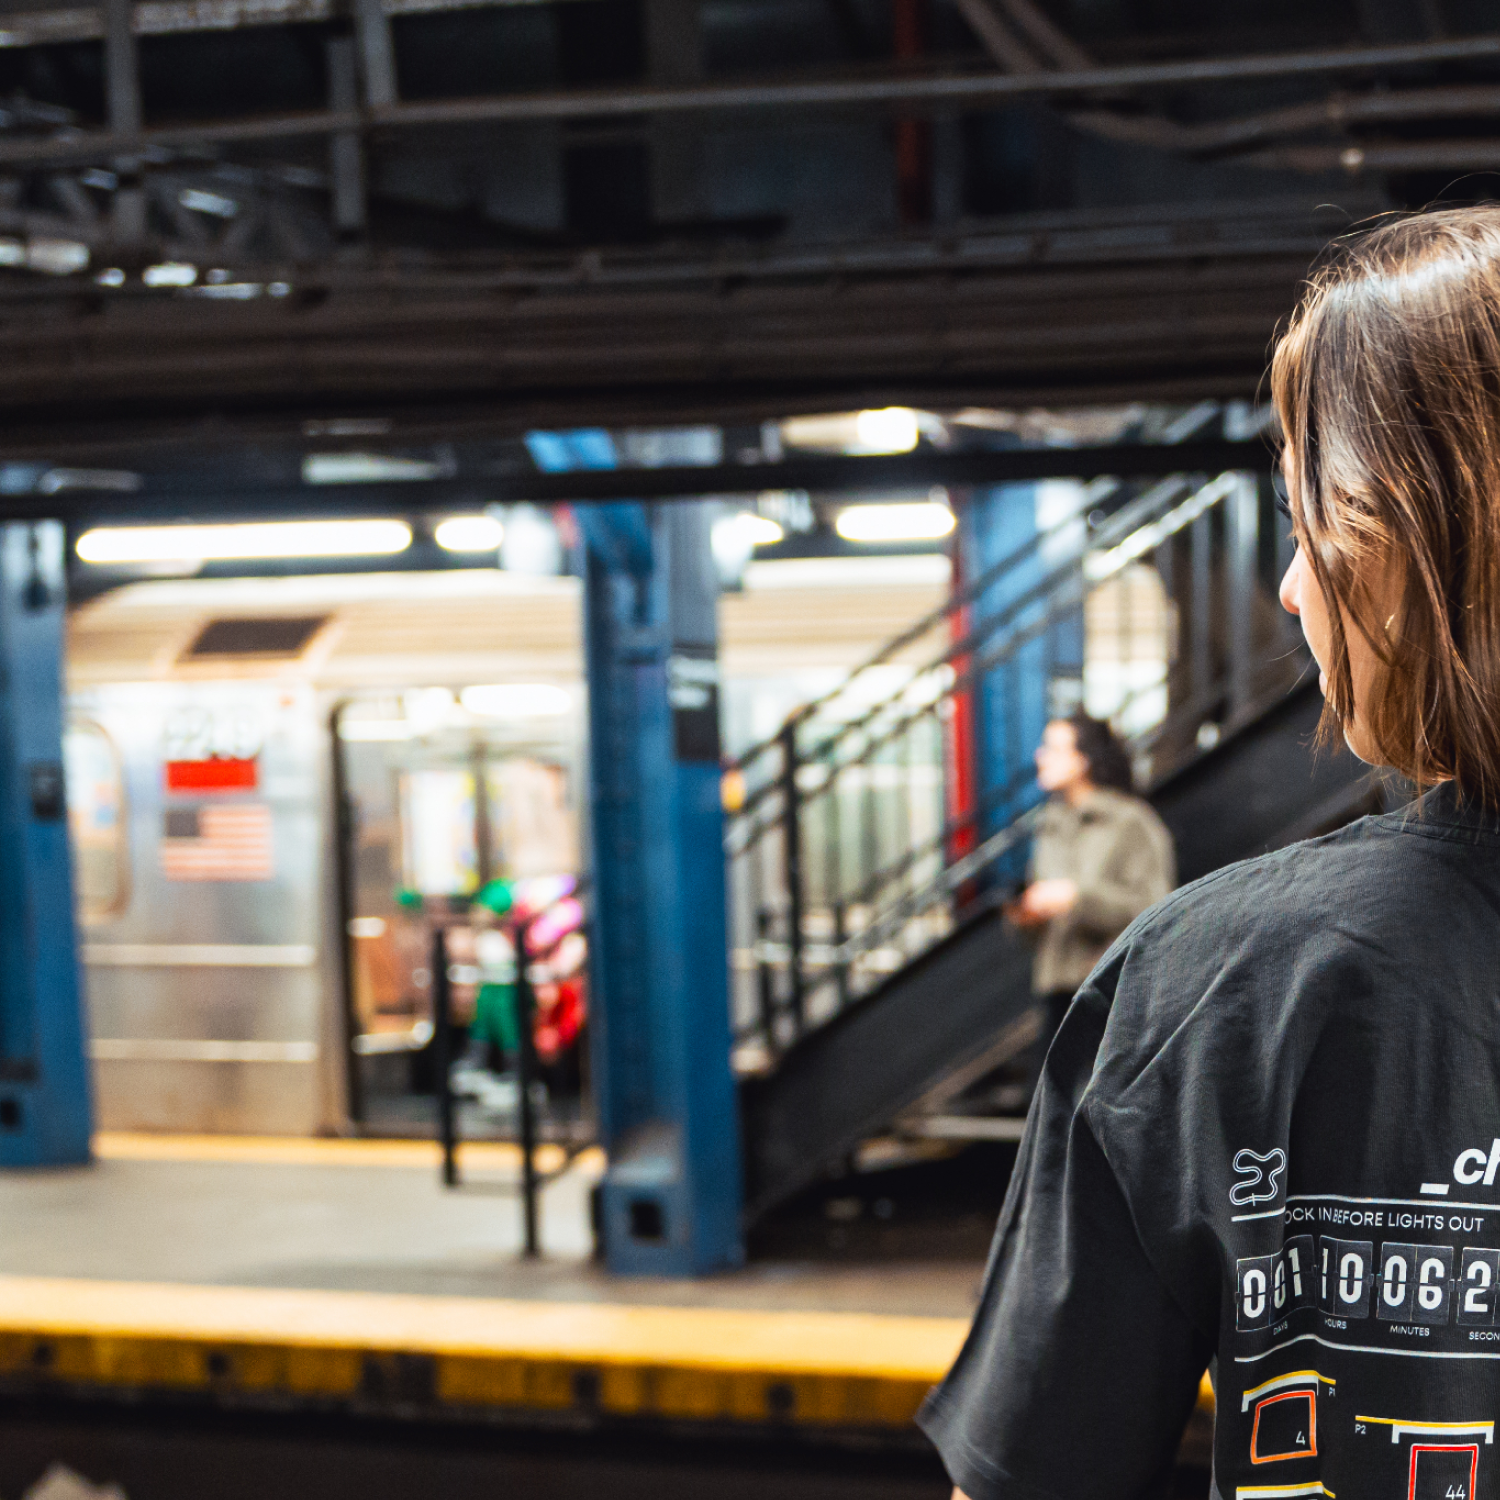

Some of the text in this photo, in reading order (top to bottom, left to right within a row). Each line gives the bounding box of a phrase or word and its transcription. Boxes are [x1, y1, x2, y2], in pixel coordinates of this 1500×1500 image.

[1387, 1212, 1444, 1230] LIGHTS
[1448, 1216, 1485, 1232] OUT
[1382, 1255, 1445, 1310] 06
[1389, 1324, 1430, 1336] MINUTES
[1355, 1424, 1366, 1435] P2
[1296, 1430, 1306, 1445] 4
[1445, 1484, 1466, 1500] 44
